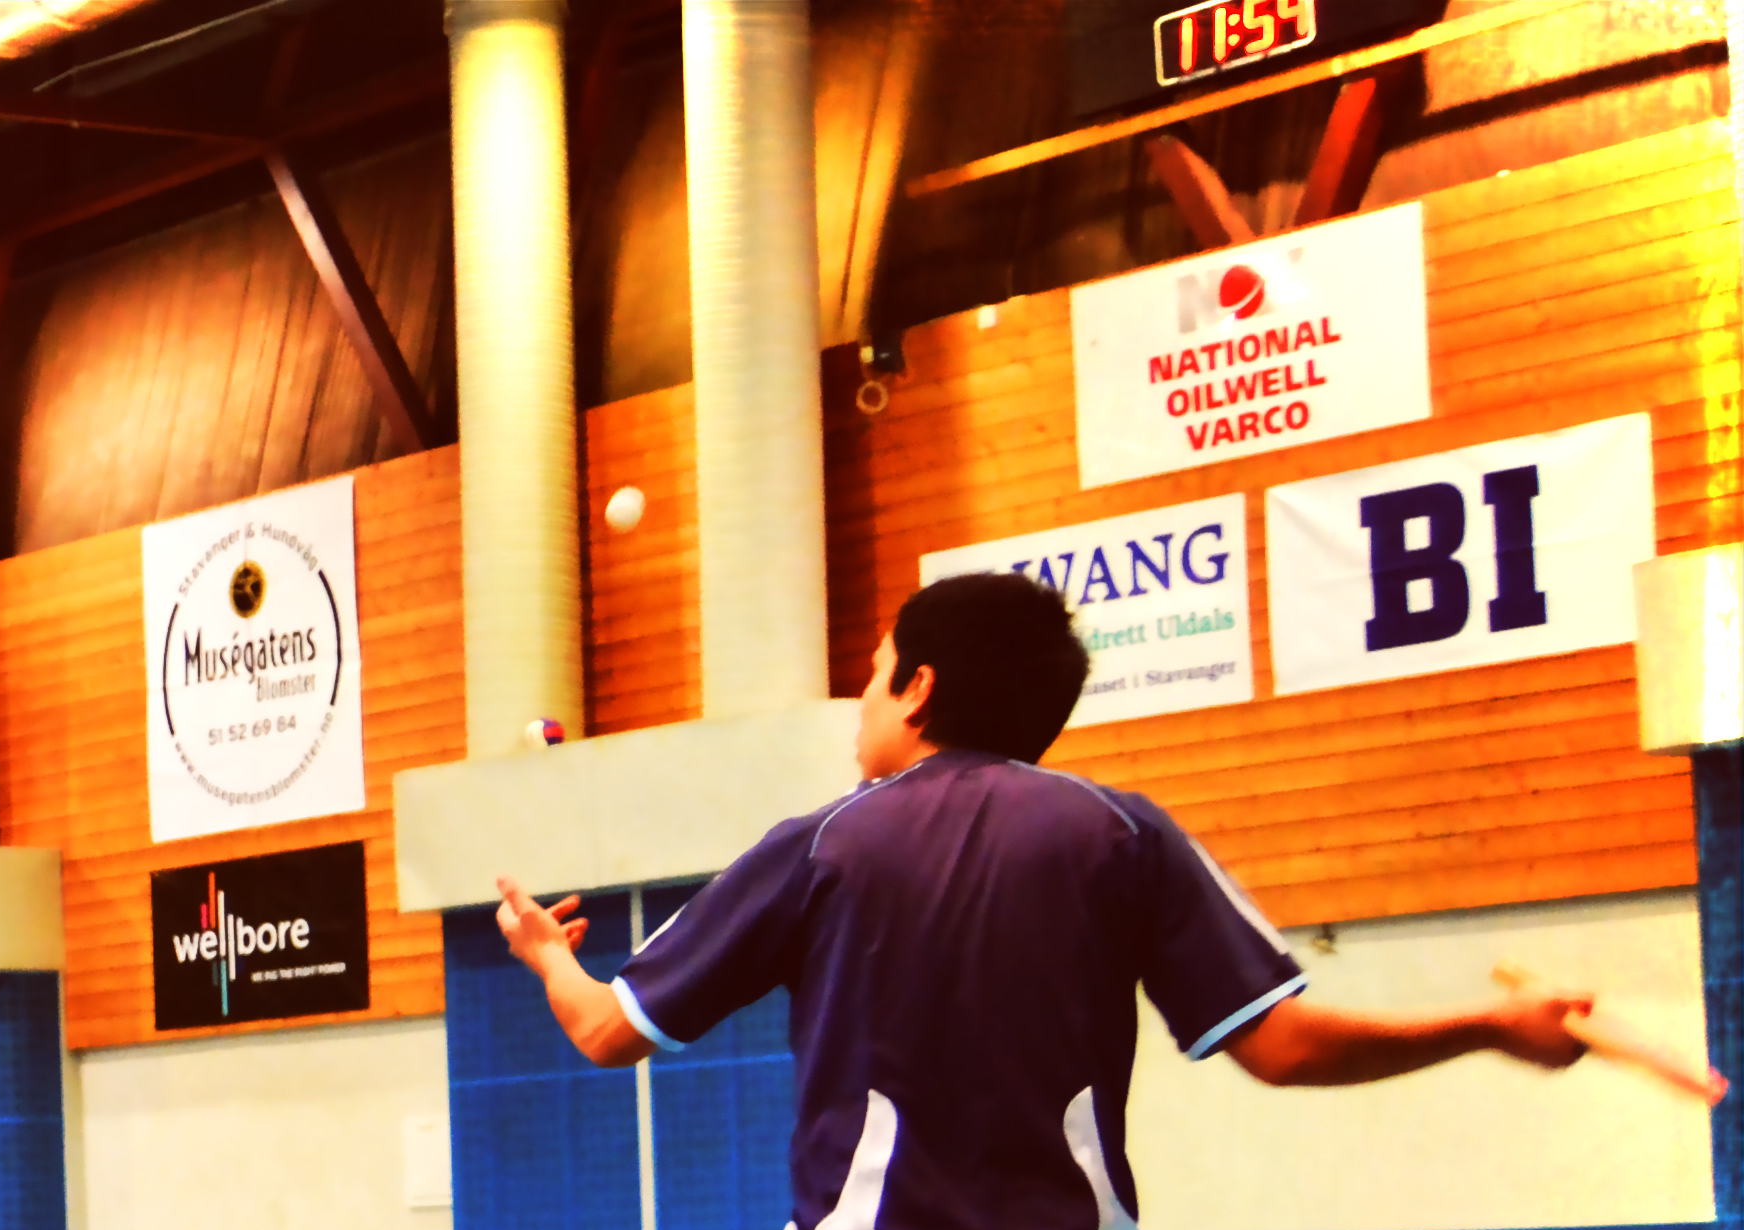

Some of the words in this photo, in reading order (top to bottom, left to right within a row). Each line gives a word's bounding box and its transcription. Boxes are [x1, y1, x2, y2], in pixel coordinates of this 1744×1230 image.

[1149, 316, 1341, 384] NATIONAL
[1166, 359, 1326, 417] OILWELL
[1186, 401, 1310, 452] VARCO
[1359, 464, 1547, 652] BI
[184, 627, 317, 687] Muségatens
[172, 890, 310, 982] wellbore
